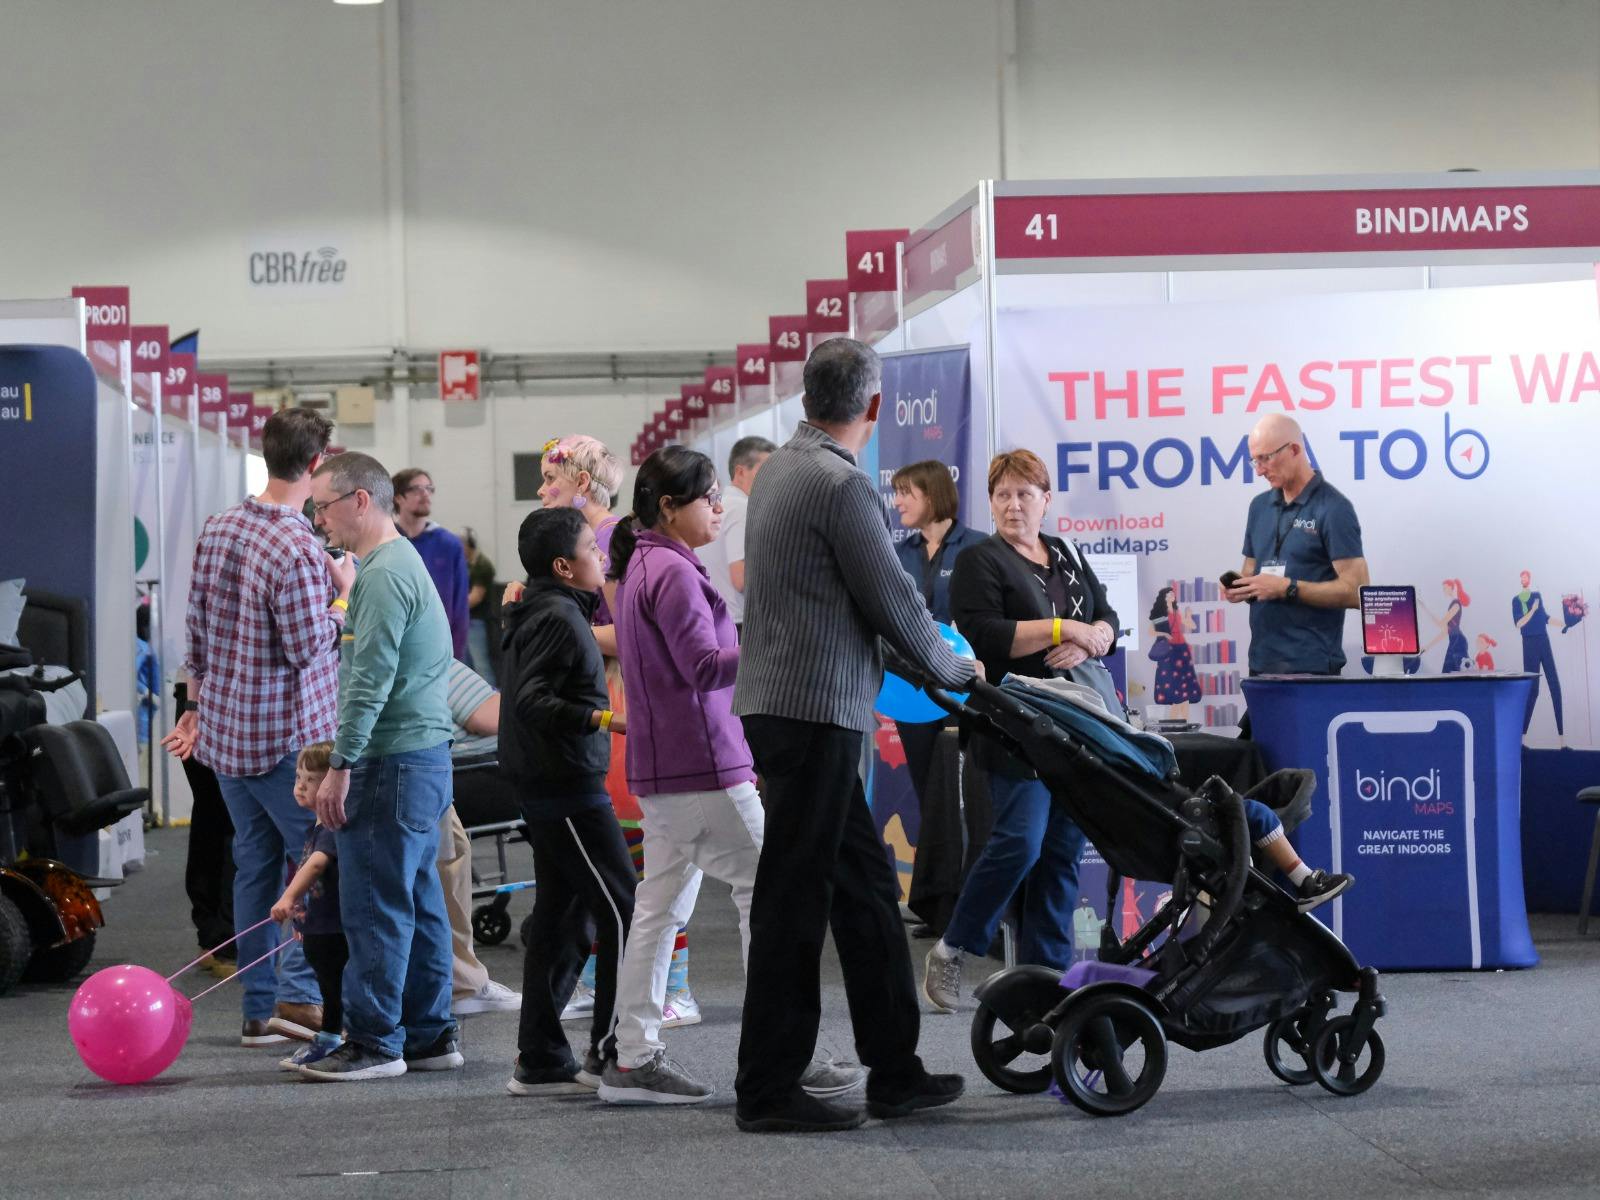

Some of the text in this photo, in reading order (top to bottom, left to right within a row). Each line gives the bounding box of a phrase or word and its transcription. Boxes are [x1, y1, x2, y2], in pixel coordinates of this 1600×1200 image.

[1025, 205, 1529, 241] 41 BINDIMAPS
[857, 251, 885, 274] 41
[816, 297, 843, 318] 42
[135, 340, 161, 360] 40
[776, 330, 801, 350] 43
[743, 356, 766, 375] 44
[165, 367, 187, 385] 39
[202, 386, 222, 404] 38
[711, 379, 731, 394] 45
[1048, 368, 1185, 421] THE
[1212, 355, 1492, 415] FASTEST
[230, 403, 249, 419] 37
[895, 388, 938, 427] bindi
[1057, 433, 1254, 492] FROM
[1340, 428, 1428, 482] TO
[1057, 511, 1165, 532] Download
[1356, 768, 1440, 801] bindi
[1414, 802, 1454, 815] MAPS
[1363, 829, 1445, 841] NAVIGATE THE
[1357, 843, 1452, 854] GREAT INDOORS
